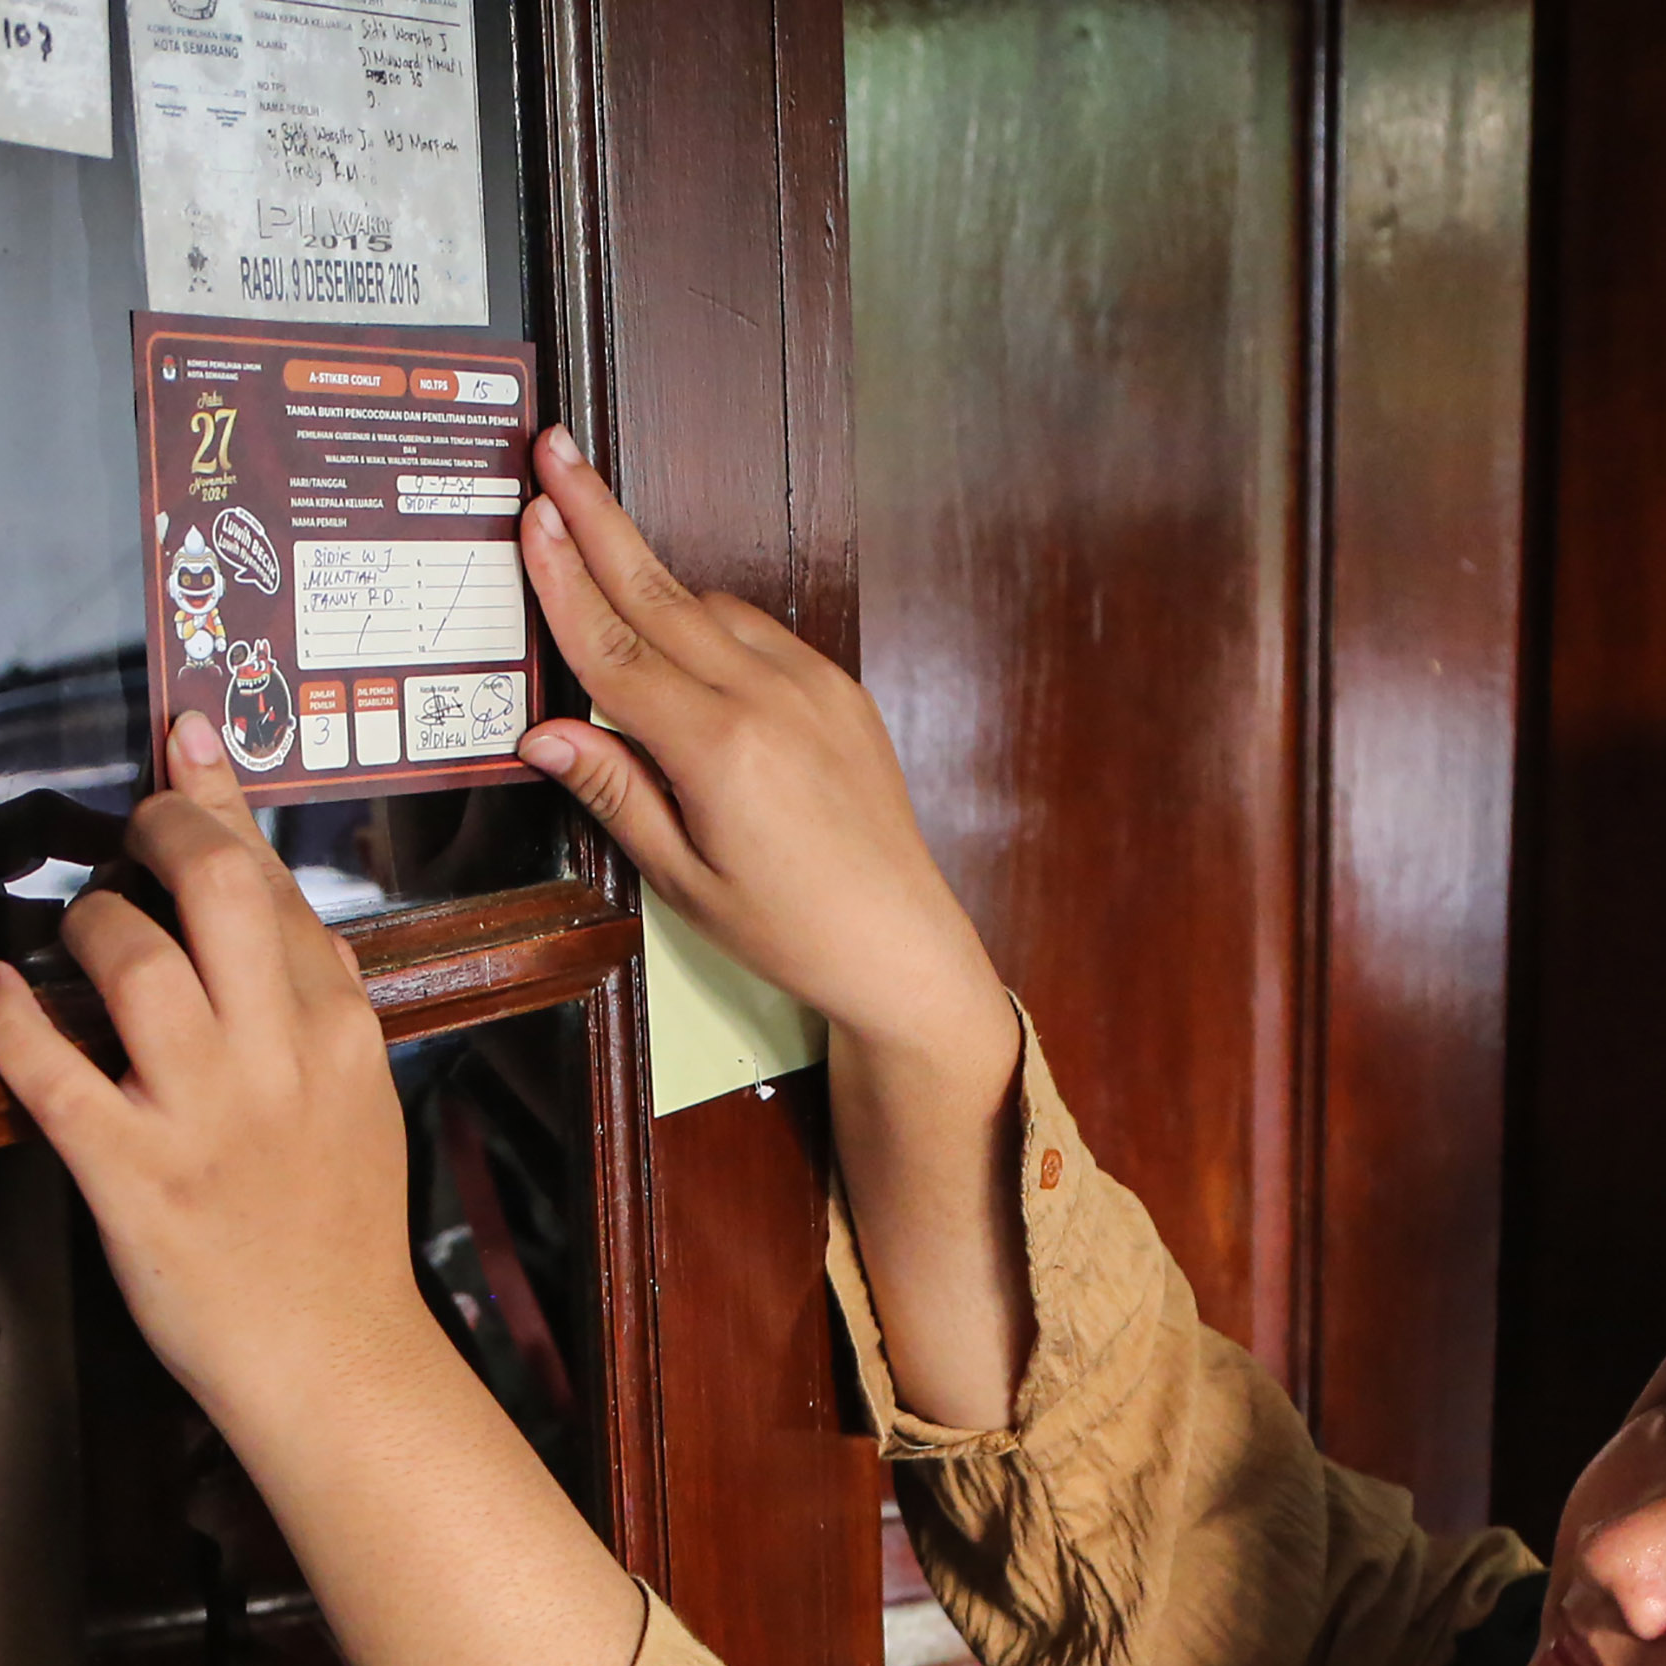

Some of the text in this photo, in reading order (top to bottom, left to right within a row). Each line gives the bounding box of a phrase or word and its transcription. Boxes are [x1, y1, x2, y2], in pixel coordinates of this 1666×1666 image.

[311, 16, 353, 32] KELUARGA
[153, 38, 239, 59] KOTA SEMARANG
[255, 40, 287, 51] ALAMAT
[257, 81, 287, 94] NO TPS
[259, 102, 320, 117] NAMA PEMILIH
[303, 234, 393, 252] 2015
[241, 256, 421, 306] RABU, 9 DESEMBER 2015
[187, 359, 209, 368] KOMISI
[209, 360, 242, 370] PEMILIHAN
[187, 370, 239, 381] KOTA SEMARANG
[309, 372, 381, 388] A-STIKER COKLIT
[419, 378, 449, 392] NO.TPS
[285, 405, 519, 428] TANDA BUKTI PENCOCOKAN DAN PENELITIAN DATA PEMILIH
[191, 408, 237, 474] 27
[297, 430, 334, 440] PEMILIHAN
[335, 431, 371, 442] GUBERNUR
[377, 433, 397, 443] WAKIL
[399, 434, 432, 444] GUBERNUR
[450, 436, 474, 446] TENGAH
[475, 438, 495, 447] TAHUN
[403, 446, 417, 454] DAN
[325, 454, 359, 465] WALIKOTA
[367, 456, 387, 465] WAKIL
[387, 456, 419, 467] WALIKOTA
[420, 458, 453, 468] SEMARANG
[453, 459, 473, 468] TAHUN
[189, 472, 237, 496] November
[289, 478, 347, 489] HARI/TANGGAL
[201, 486, 227, 502] 2024
[291, 498, 385, 509] NAMA KEPALA KELUARGA
[291, 518, 347, 528] NAMA PEMILIH
[222, 514, 251, 549] Luwih
[251, 539, 277, 580] BECIK
[309, 690, 335, 700] JUMLAH
[369, 686, 395, 696] PEMILIH
[309, 700, 336, 710] PEMILIH
[357, 696, 394, 707] DISABILITAS
[313, 716, 331, 746] 3
